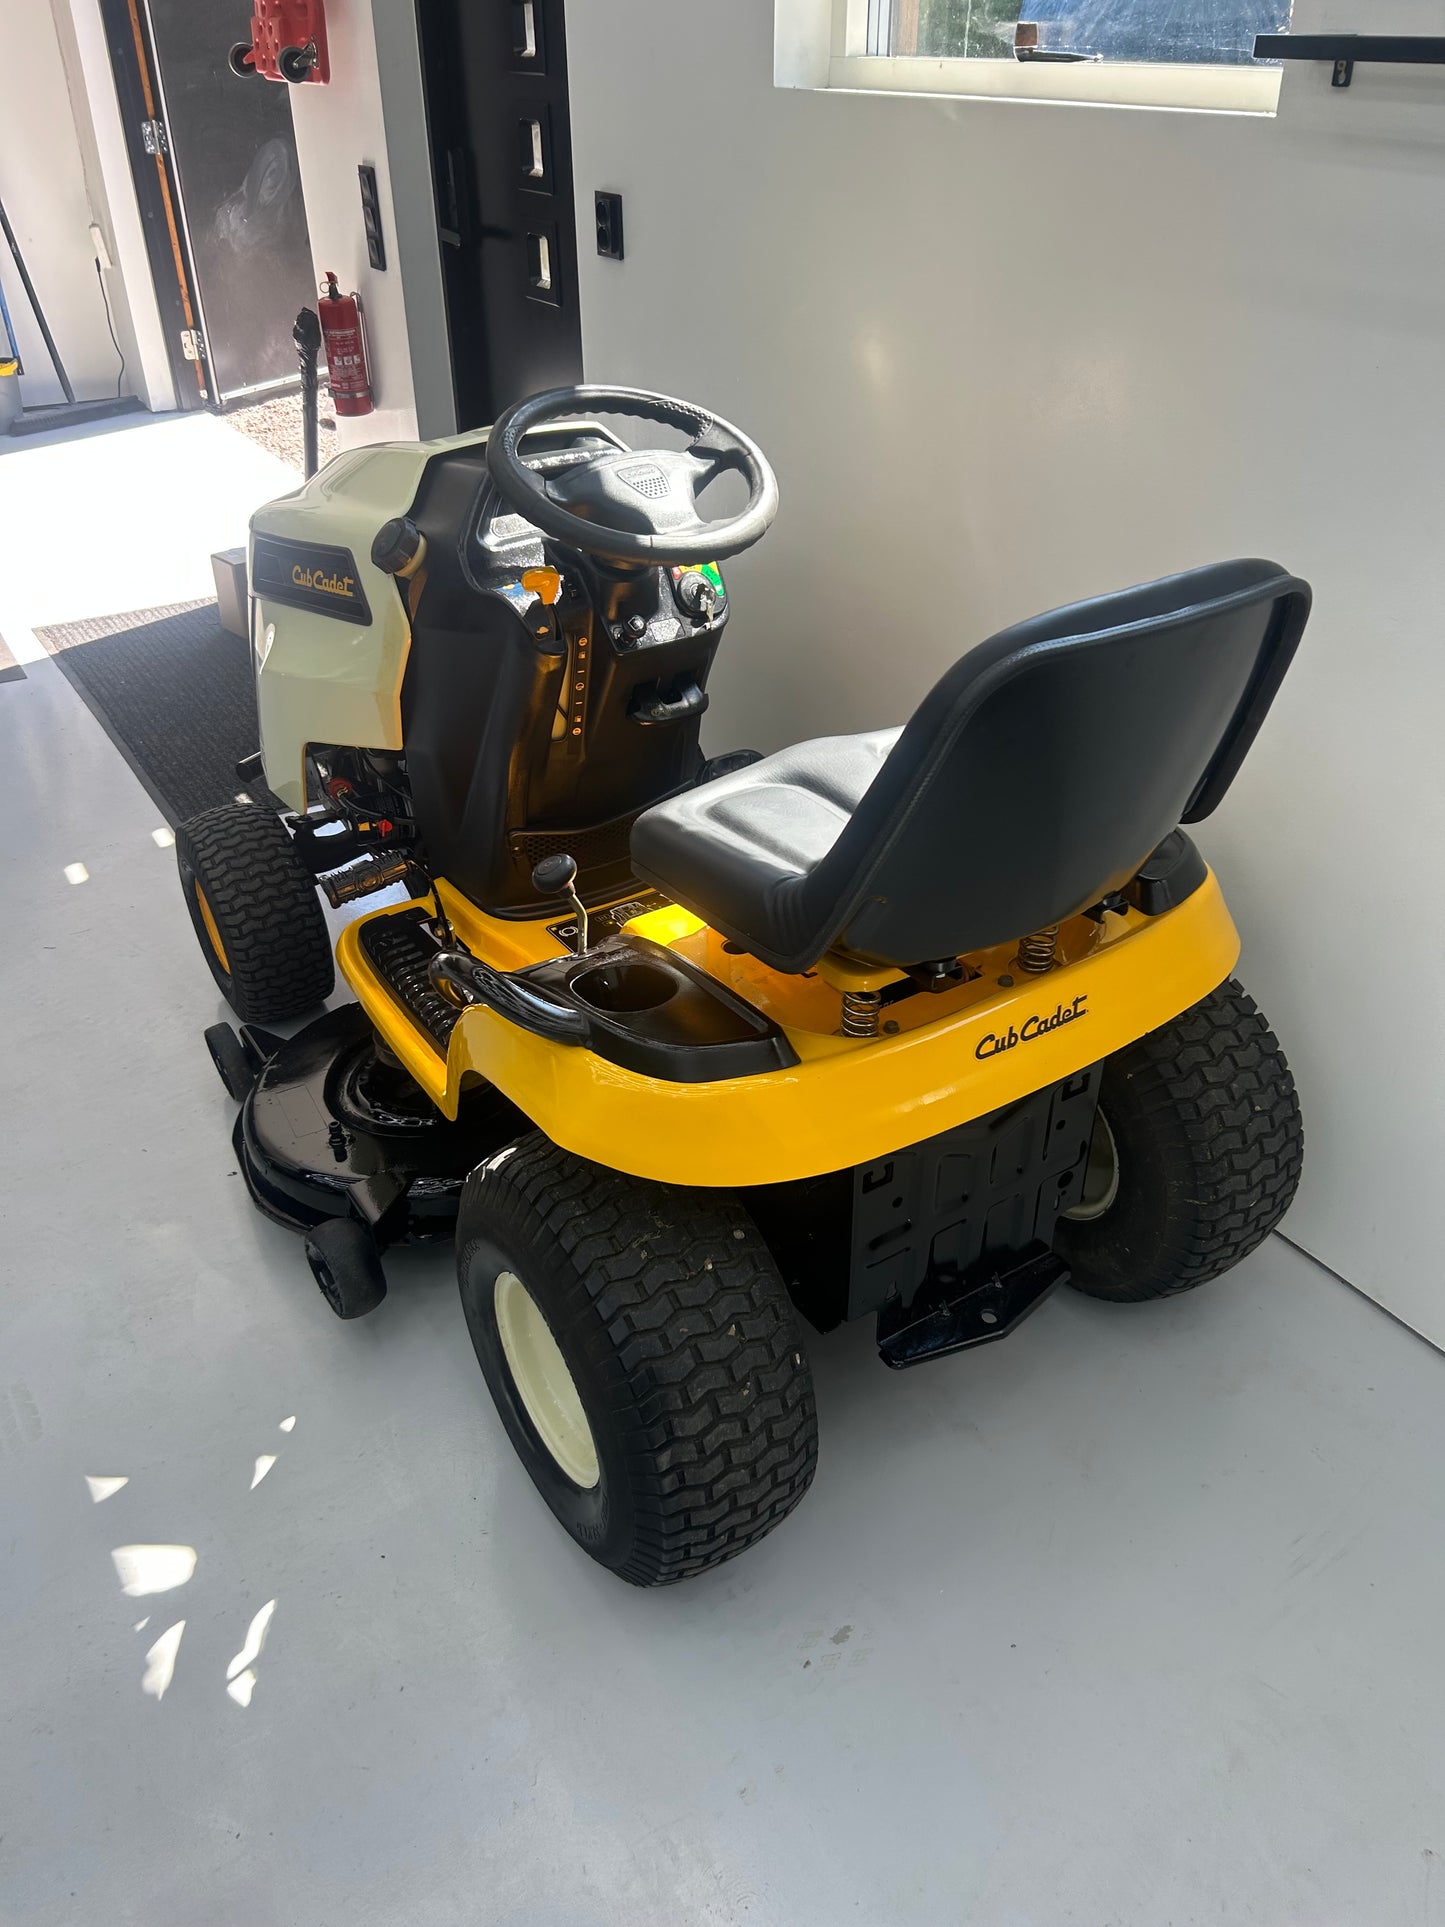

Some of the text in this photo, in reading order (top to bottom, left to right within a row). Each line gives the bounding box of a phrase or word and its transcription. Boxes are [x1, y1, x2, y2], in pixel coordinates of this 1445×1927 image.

[292, 564, 354, 597] Cub Cadet
[975, 994, 1088, 1060] Cub Cadet
